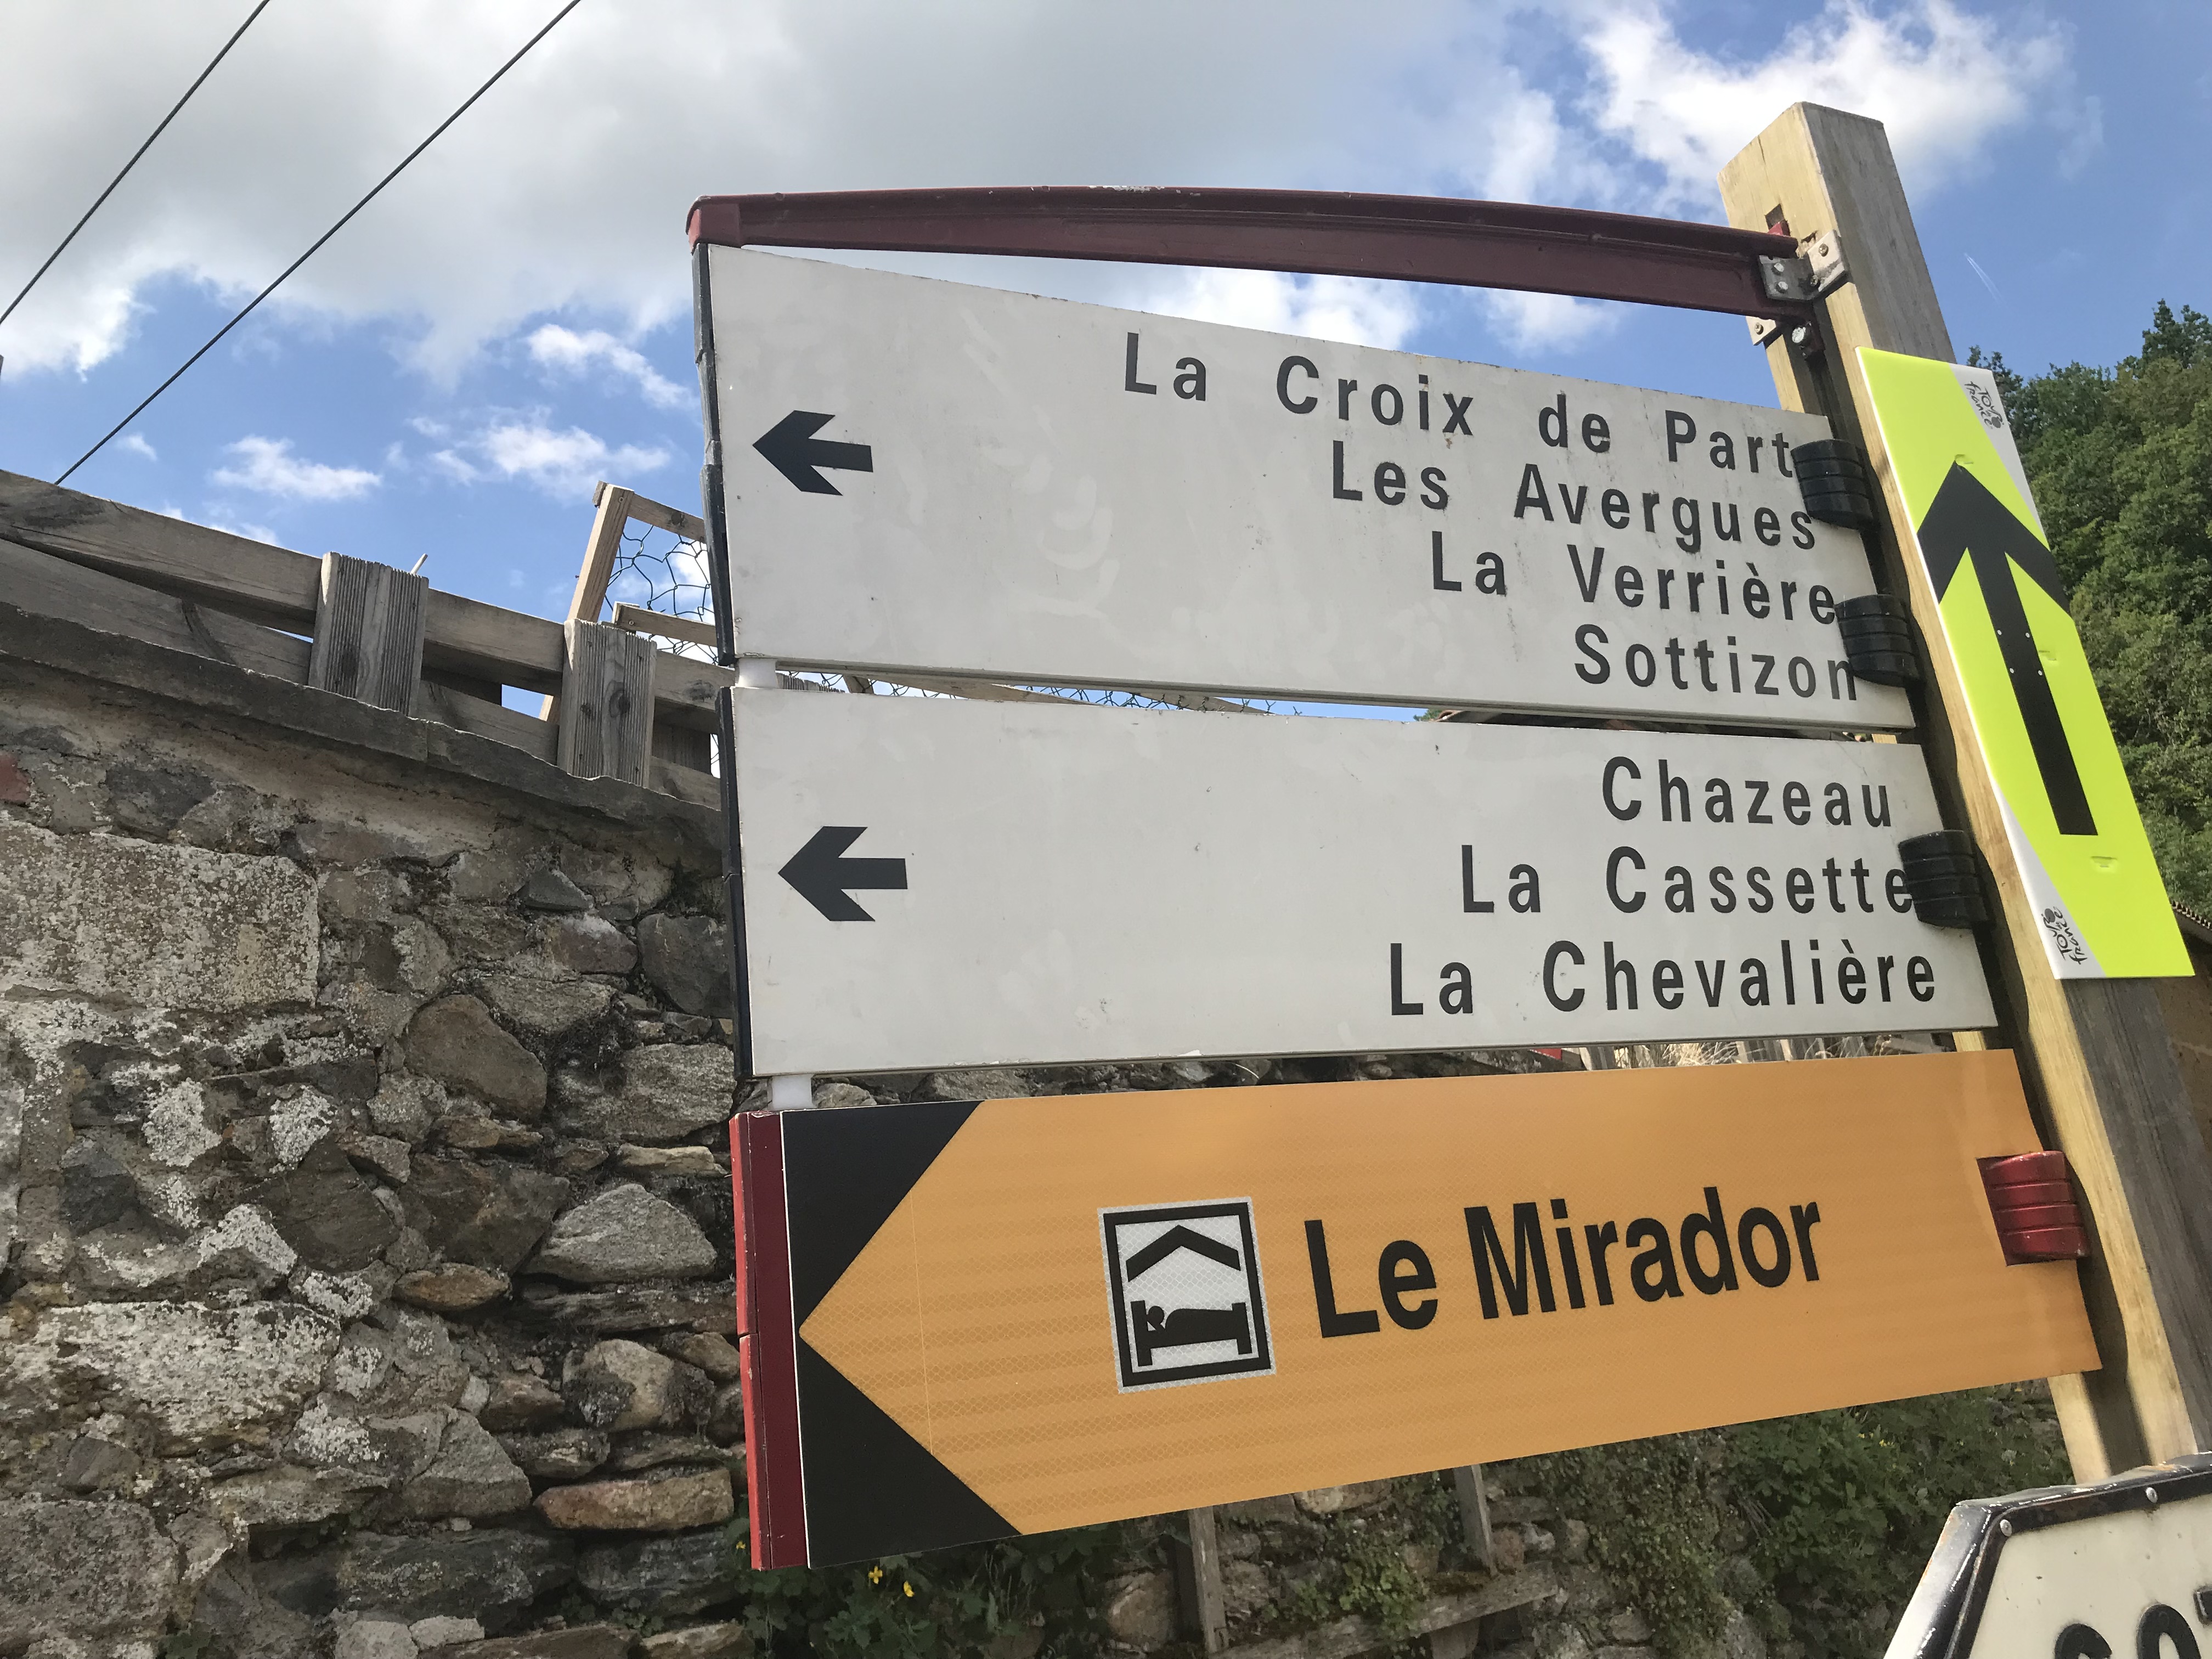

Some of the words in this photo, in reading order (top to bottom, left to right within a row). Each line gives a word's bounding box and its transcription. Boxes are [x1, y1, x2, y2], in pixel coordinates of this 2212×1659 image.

[1125, 332, 1206, 402] La
[1276, 356, 1474, 437] Croix
[1538, 393, 1611, 454] de
[1665, 410, 1793, 478] Part
[1333, 440, 1450, 511] Les
[1514, 463, 1815, 554] Avergues
[1432, 531, 1507, 597] La
[1566, 544, 1836, 625] Verrière
[1574, 624, 1857, 701] Sottizon
[1602, 756, 1892, 828] Chazeau
[1462, 844, 1541, 913] La
[1606, 846, 1913, 914] Cassette
[1390, 943, 1473, 1015] La
[1543, 939, 1935, 1013] Chevalière
[1304, 1219, 1438, 1339] Le
[1463, 1186, 1822, 1321] Mirador
